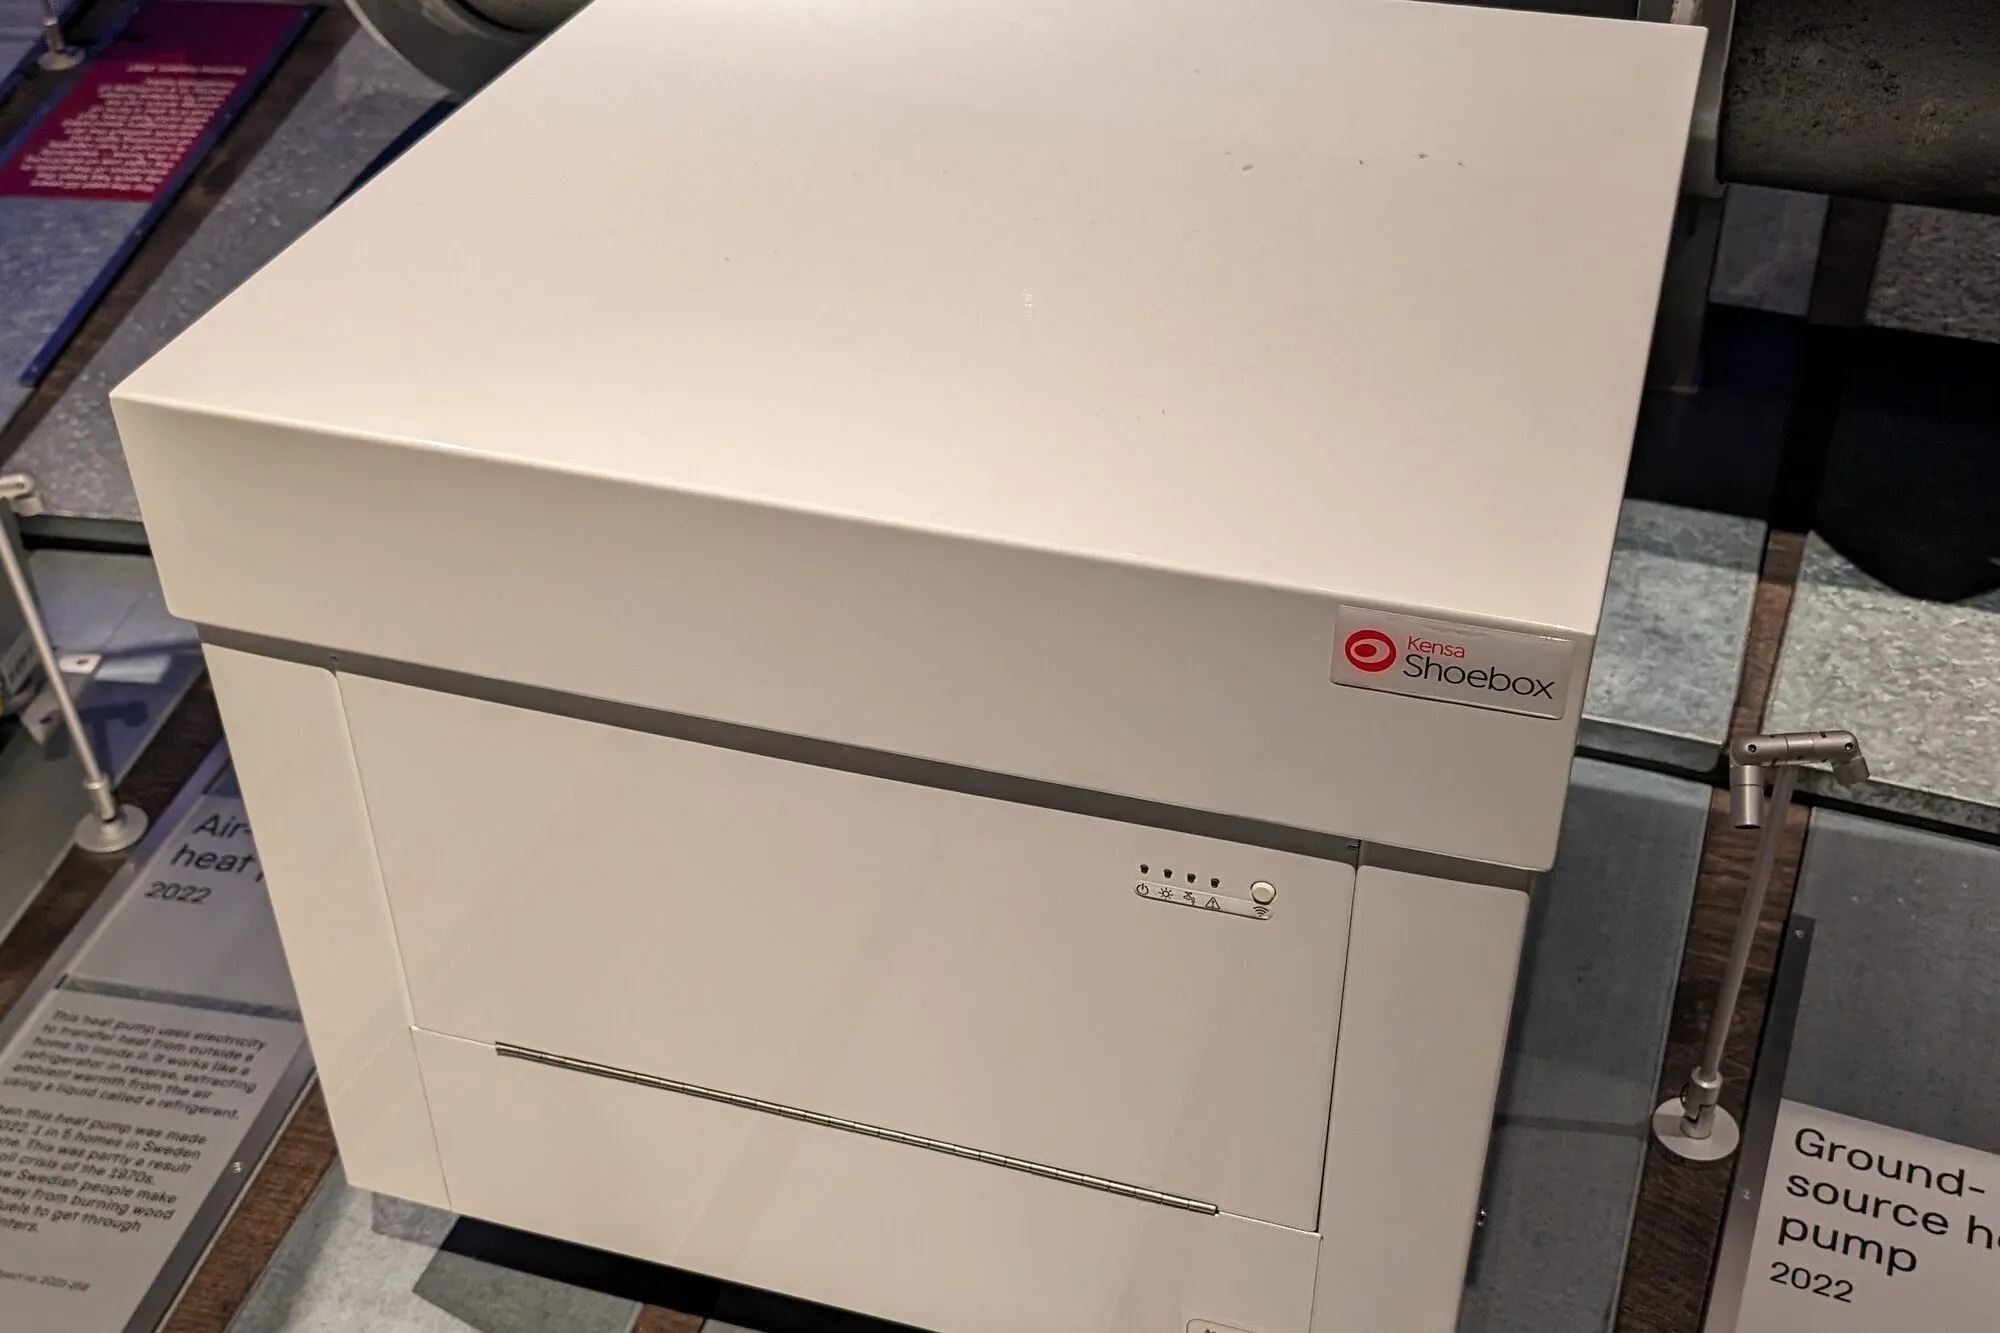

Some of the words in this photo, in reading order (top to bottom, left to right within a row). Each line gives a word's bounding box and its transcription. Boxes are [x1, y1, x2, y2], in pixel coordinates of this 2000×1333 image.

[1407, 636, 1466, 659] Kensa
[1402, 653, 1555, 700] Shoebox
[170, 842, 257, 874] heat
[145, 880, 212, 904] 2022
[41, 1023, 57, 1034] to
[60, 1026, 116, 1041] transfer
[119, 1035, 151, 1046] heat
[152, 1039, 186, 1051] from
[189, 1046, 242, 1059] outside
[245, 1053, 254, 1062] a
[53, 1010, 79, 1022] This
[82, 1015, 115, 1026] heat
[113, 1021, 155, 1035] pump
[158, 1028, 192, 1038] uses
[193, 1032, 267, 1051] electricity
[22, 1051, 105, 1069] refrigerator
[107, 1062, 121, 1071] in
[123, 1065, 178, 1079] reverse,
[183, 1074, 257, 1094] extracting
[34, 1036, 71, 1049] home
[75, 1043, 90, 1053] to
[92, 1046, 134, 1059] inside
[167, 1058, 209, 1070] works
[212, 1061, 238, 1073] like
[240, 1067, 251, 1076] a
[4, 1077, 42, 1092] using
[44, 1082, 54, 1091] a
[56, 1083, 98, 1098] liquid
[99, 1091, 145, 1104] called
[145, 1098, 156, 1106] a
[157, 1100, 240, 1119] refrigerant.
[13, 1064, 72, 1078] ambient
[73, 1073, 125, 1087] warmth
[128, 1079, 163, 1093] from
[165, 1085, 190, 1096] the
[192, 1089, 212, 1099] air
[0, 1104, 23, 1117] hen
[26, 1108, 53, 1120] this
[55, 1113, 89, 1126] heat
[88, 1120, 132, 1135] pump
[135, 1126, 163, 1138] was
[165, 1131, 208, 1145] made
[44, 1128, 60, 1138] in
[74, 1131, 123, 1148] homes
[125, 1138, 140, 1150] in
[143, 1141, 202, 1160] Sweden
[19, 1155, 59, 1169] crisis
[61, 1162, 80, 1172] of
[80, 1164, 106, 1176] the
[108, 1167, 155, 1187] 1970s.
[27, 1138, 55, 1153] This
[58, 1146, 86, 1158] was
[86, 1150, 132, 1167] partly
[135, 1158, 145, 1166] a
[146, 1160, 192, 1175] result
[1795, 1127, 1986, 1198] Ground-
[0, 1185, 30, 1199] way
[32, 1188, 68, 1202] from
[70, 1195, 130, 1216] burning
[132, 1205, 176, 1220] wood
[17, 1169, 78, 1188] Swedish
[78, 1181, 134, 1197] people
[136, 1189, 178, 1204] make
[33, 1205, 50, 1217] to
[50, 1209, 80, 1222] get
[82, 1212, 141, 1233] through
[1786, 1174, 1949, 1235] source
[1967, 1214, 2000, 1250] h
[1778, 1215, 1917, 1276] pump
[1769, 1261, 1854, 1304] 2022
